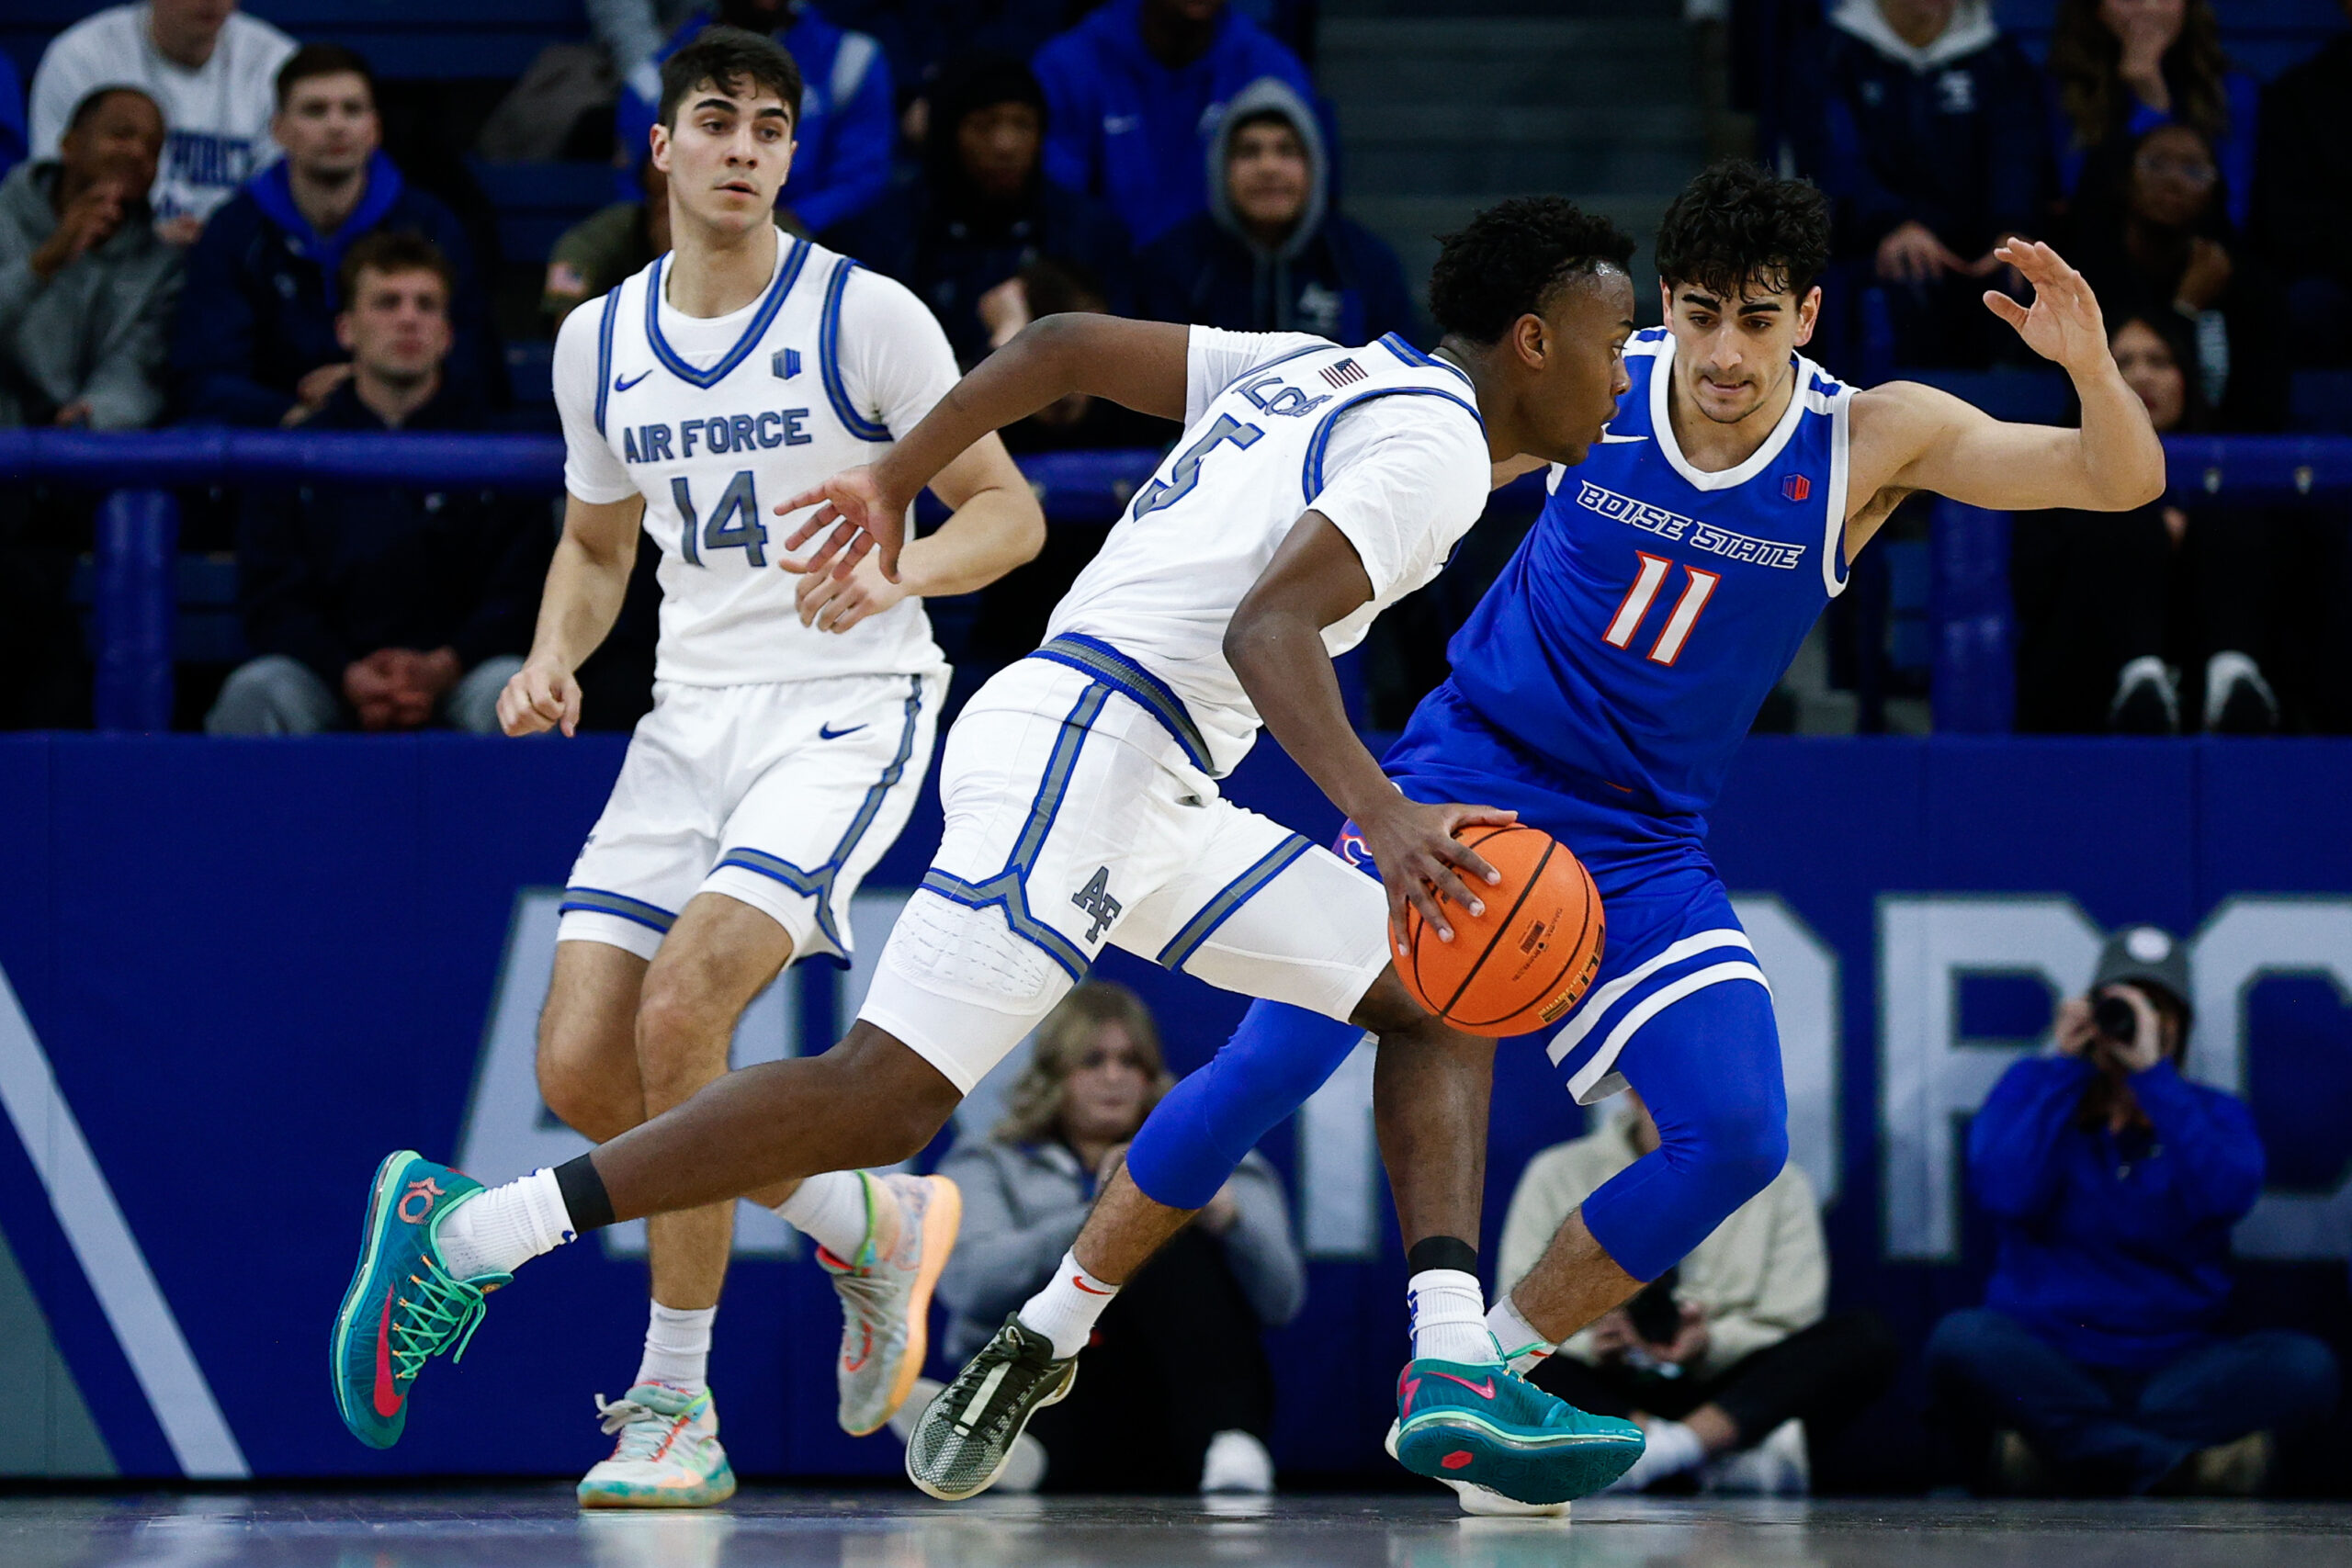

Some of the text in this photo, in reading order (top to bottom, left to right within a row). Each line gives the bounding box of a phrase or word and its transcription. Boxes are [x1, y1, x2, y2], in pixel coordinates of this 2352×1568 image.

[622, 407, 813, 464] AIR FORCE
[1132, 412, 1266, 524] 5
[670, 469, 769, 570] 14
[1576, 479, 1806, 570] BOISE STATE
[1600, 549, 1722, 668] 11
[1070, 865, 1123, 944] AF
